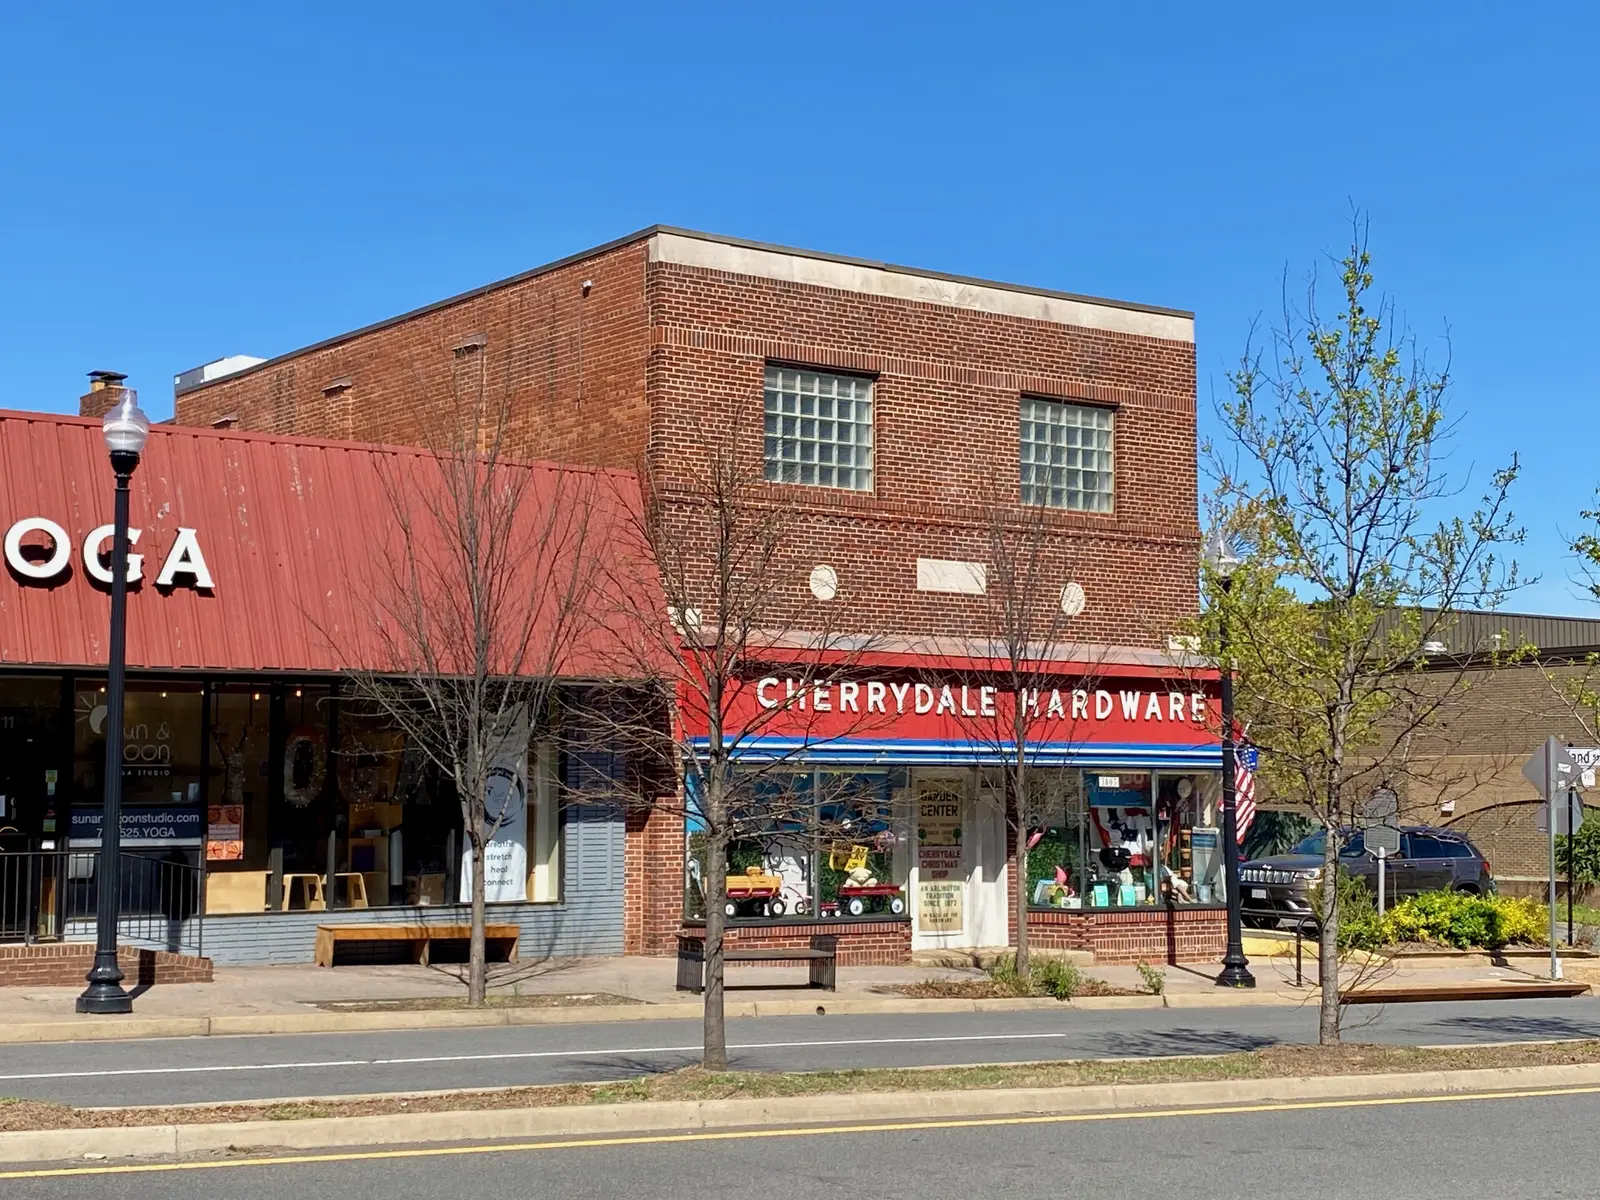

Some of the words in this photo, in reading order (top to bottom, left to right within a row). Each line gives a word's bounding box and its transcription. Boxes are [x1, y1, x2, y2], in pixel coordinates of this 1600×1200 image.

[4, 517, 215, 588] OGA
[757, 677, 997, 717] CHERRYDALE
[1021, 688, 1206, 722] HARDWARE
[123, 724, 148, 740] un
[156, 721, 171, 740] &
[123, 744, 170, 762] oon
[920, 789, 958, 802] GARDEN
[920, 804, 958, 817] CENTER
[486, 853, 513, 861] stretch
[918, 850, 961, 859] CHERRYDALE
[490, 865, 508, 874] heal
[921, 860, 958, 869] CHRISTMAS
[931, 870, 949, 879] SHOP
